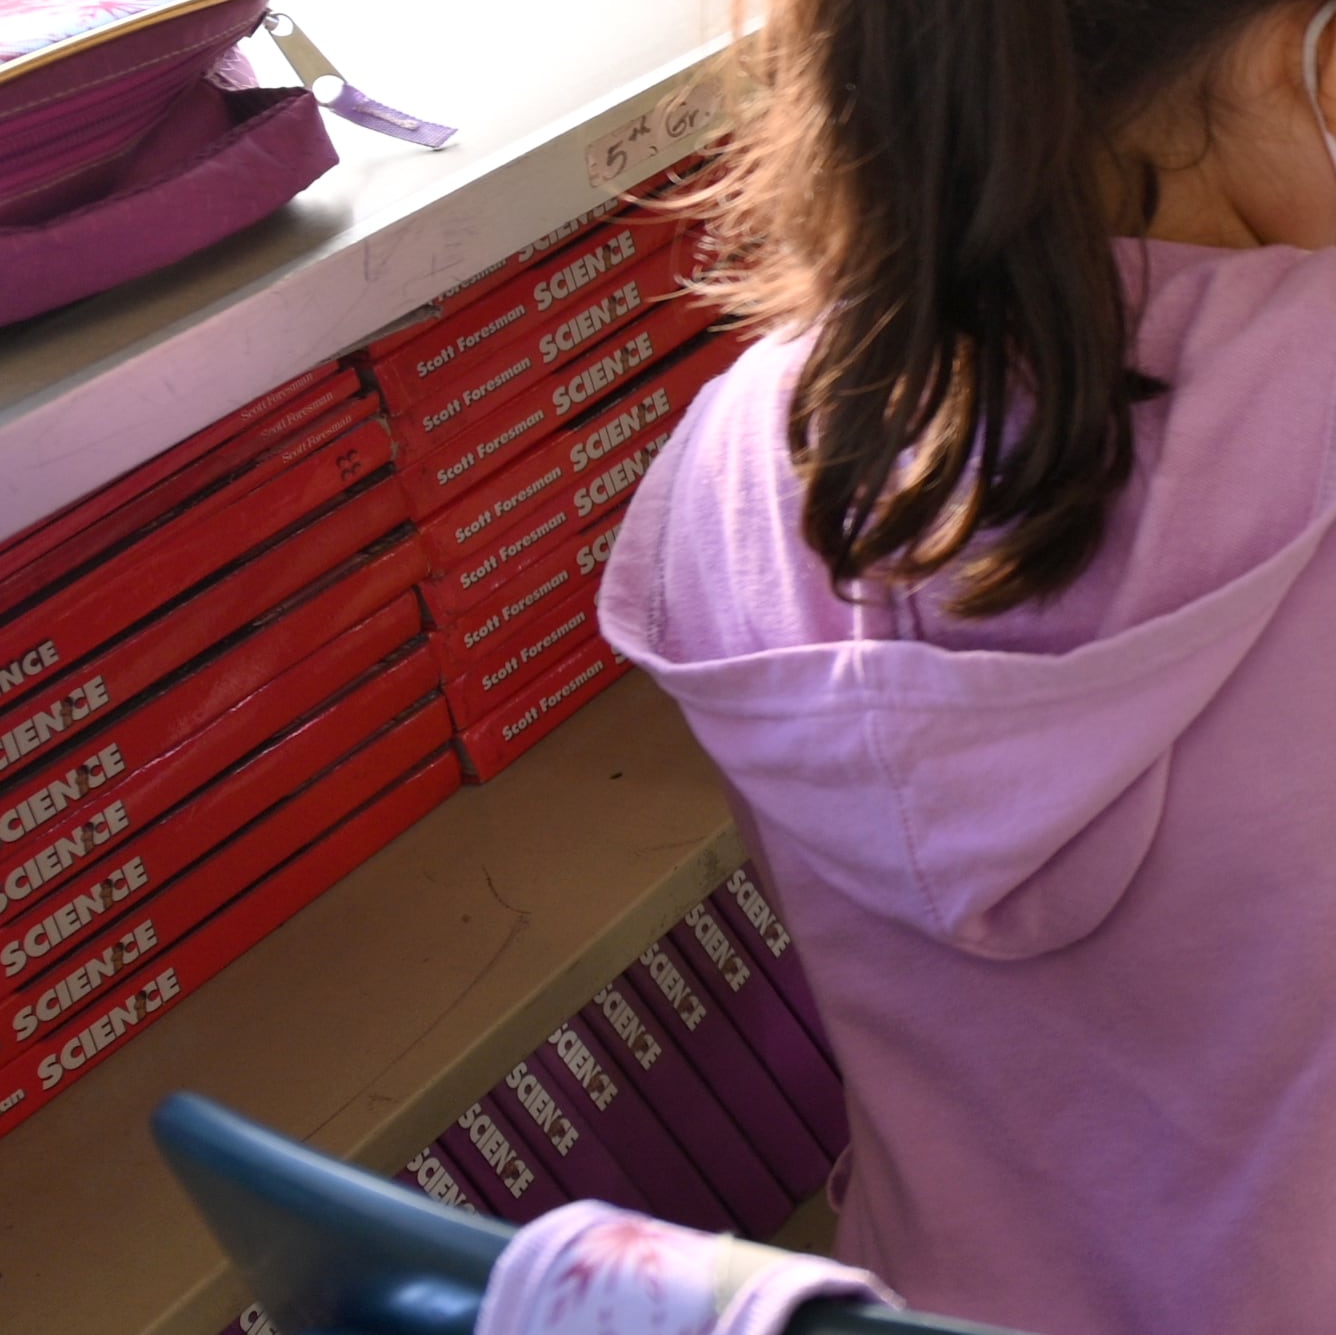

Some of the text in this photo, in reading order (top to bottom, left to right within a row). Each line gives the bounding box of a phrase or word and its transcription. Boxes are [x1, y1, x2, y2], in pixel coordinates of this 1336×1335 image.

[417, 230, 636, 377] Scott Foresman SCIENCE
[423, 280, 641, 432] Scott Foresman SCIENCE
[437, 332, 654, 486] Scott Foresman SCIENCE
[455, 387, 670, 544] Scott Foresman SCIENCE
[460, 555, 498, 589] Scott
[499, 512, 566, 562] Foresman
[464, 614, 500, 649] Scott
[502, 569, 569, 622] Foresman
[482, 657, 518, 691] Scott
[520, 610, 586, 663] Foresman
[502, 659, 604, 741] Scott Foresman
[2, 856, 149, 976] SCIENCE
[685, 903, 751, 992] SCIENCE
[726, 869, 791, 958] SCIENCE
[12, 919, 158, 1042] SCIENCE
[640, 943, 707, 1032] SCIENCE
[37, 967, 181, 1090] SCIENCE
[458, 1102, 535, 1199] SCIENCE
[505, 1062, 580, 1156] SCIENCE
